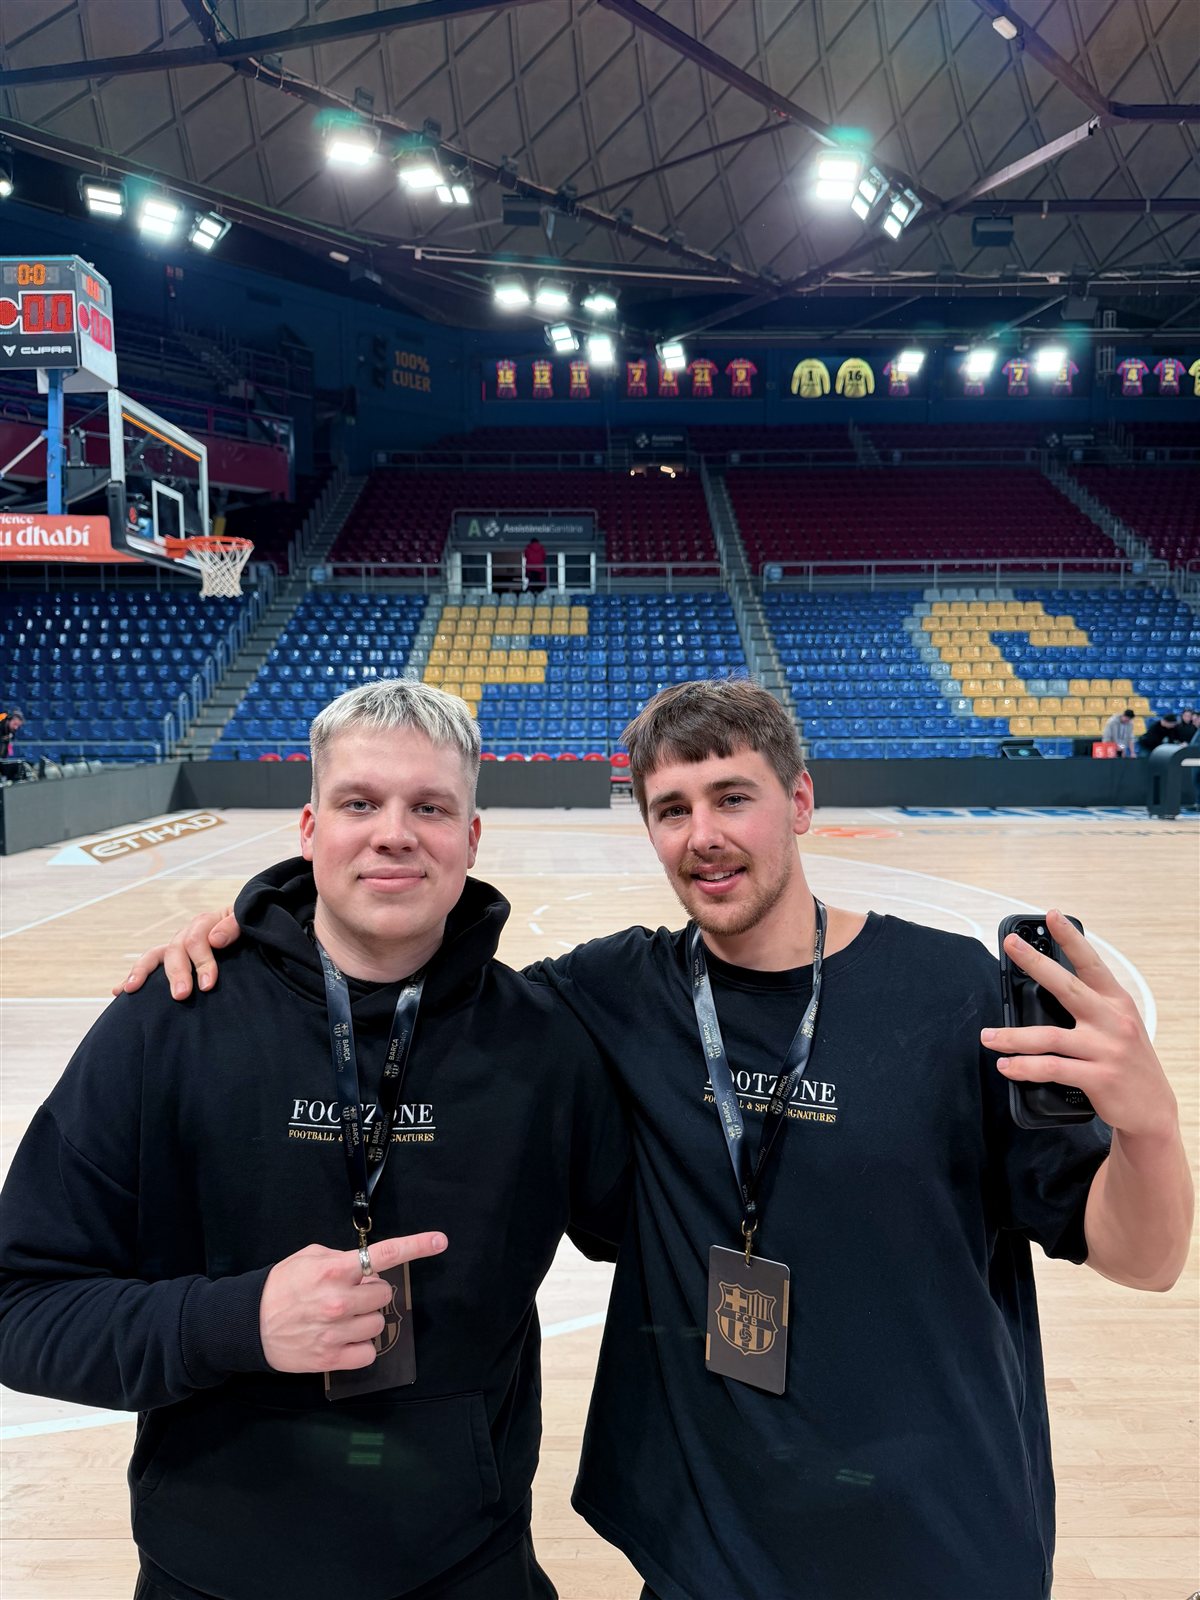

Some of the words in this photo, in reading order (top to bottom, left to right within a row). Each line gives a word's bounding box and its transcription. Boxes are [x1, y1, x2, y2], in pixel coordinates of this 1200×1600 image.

[21, 346, 72, 354] CUPRA
[394, 351, 430, 373] 100%
[392, 369, 431, 392] CULER
[498, 369, 513, 383] 15
[534, 370, 550, 383] 12
[632, 369, 641, 382] 7
[694, 369, 709, 382] 21
[808, 370, 814, 381] 1
[848, 370, 862, 381] 16
[1014, 369, 1023, 381] 7
[1164, 368, 1174, 381] 2
[468, 519, 481, 537] A
[91, 815, 218, 857] ETIHAD
[703, 1023, 712, 1044] BARÇA
[342, 1039, 351, 1062] BARÇA
[388, 1038, 399, 1061] BARÇA
[775, 1075, 788, 1097] BARÇA
[782, 1067, 799, 1100] Hospitality
[721, 1101, 733, 1123] BARÇA
[746, 1101, 753, 1110] &
[288, 1129, 335, 1142] FOOTBALL
[351, 1122, 360, 1146] BARÇA
[371, 1121, 383, 1144] BARÇA
[735, 1313, 758, 1326] FCB
